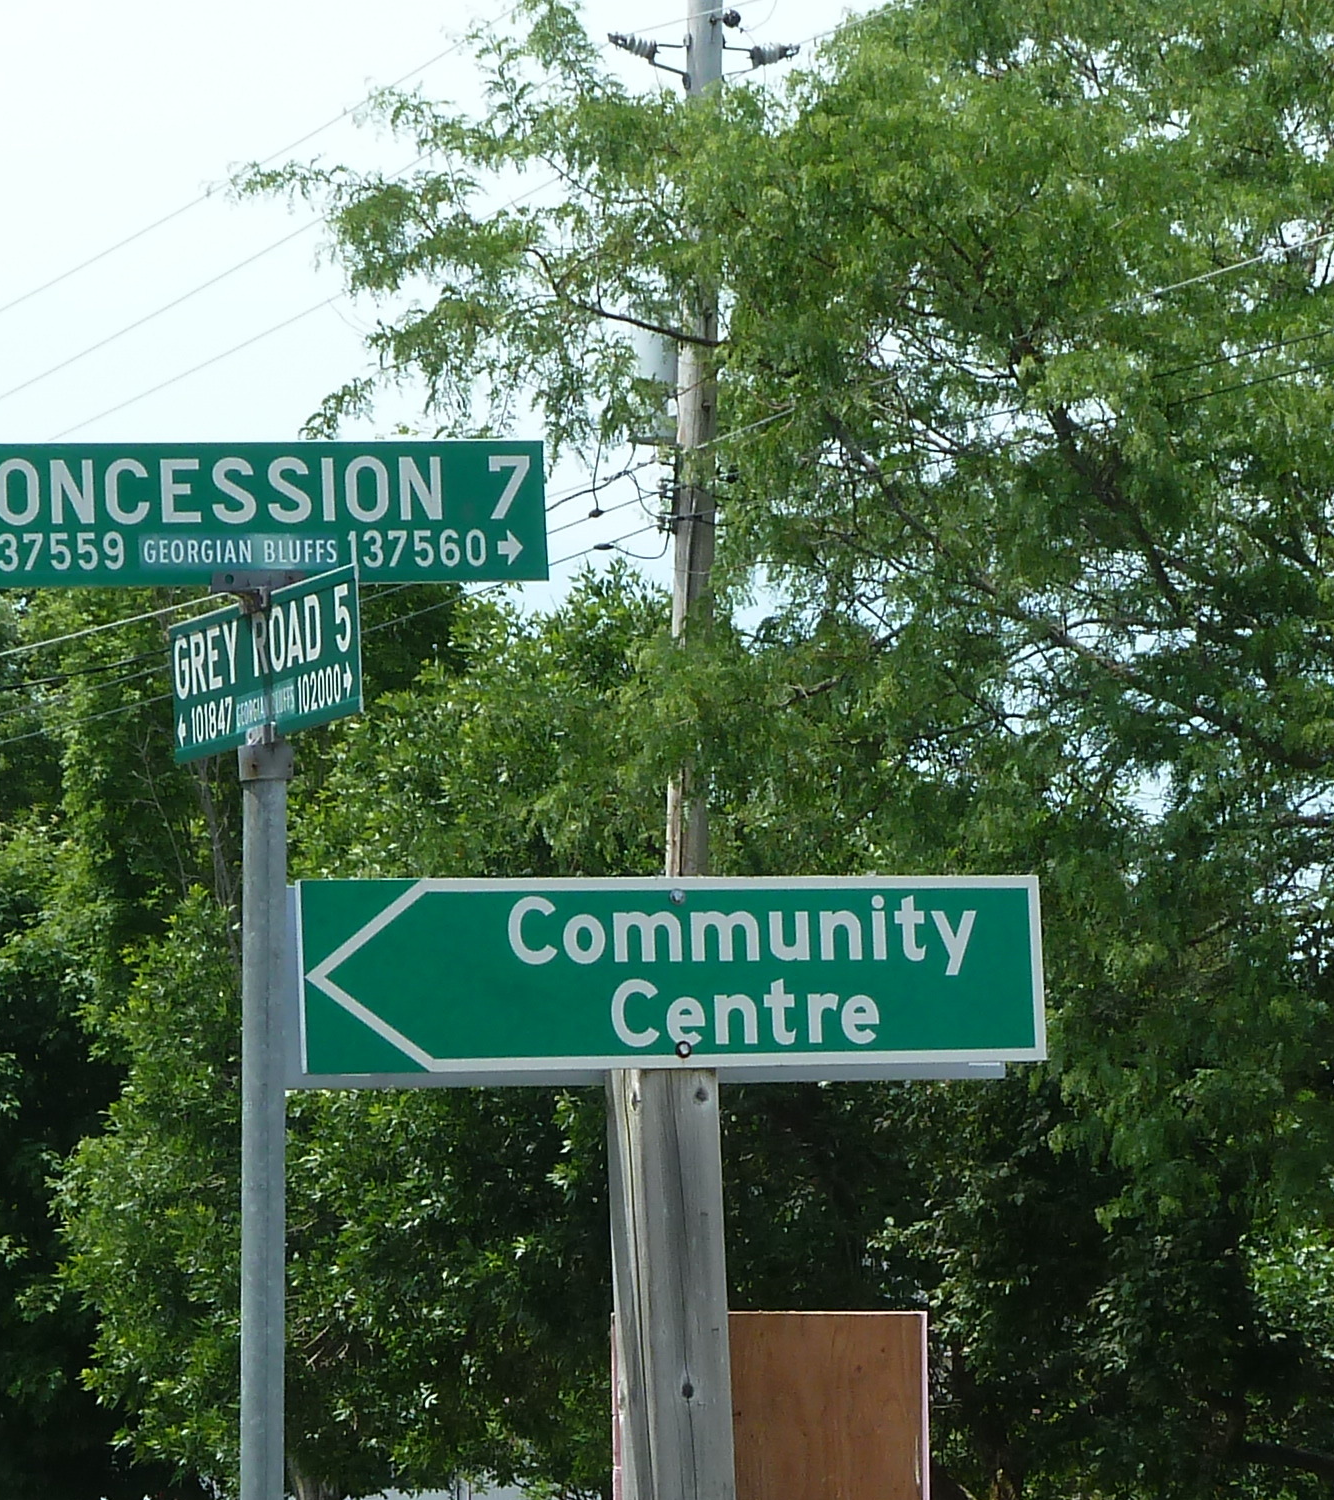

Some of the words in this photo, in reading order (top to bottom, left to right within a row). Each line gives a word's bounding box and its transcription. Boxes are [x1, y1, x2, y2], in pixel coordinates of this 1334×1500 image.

[488, 455, 531, 520] 7
[143, 539, 252, 564] GEORGIAN
[264, 539, 338, 564] BLUFFS
[347, 529, 487, 567] 137560
[174, 619, 238, 700] GREY
[251, 594, 322, 678] ROAD
[334, 583, 352, 653] 5
[190, 696, 233, 744] 101847
[297, 663, 342, 715] 102000
[508, 895, 977, 976] Community
[611, 978, 880, 1048] Centre
